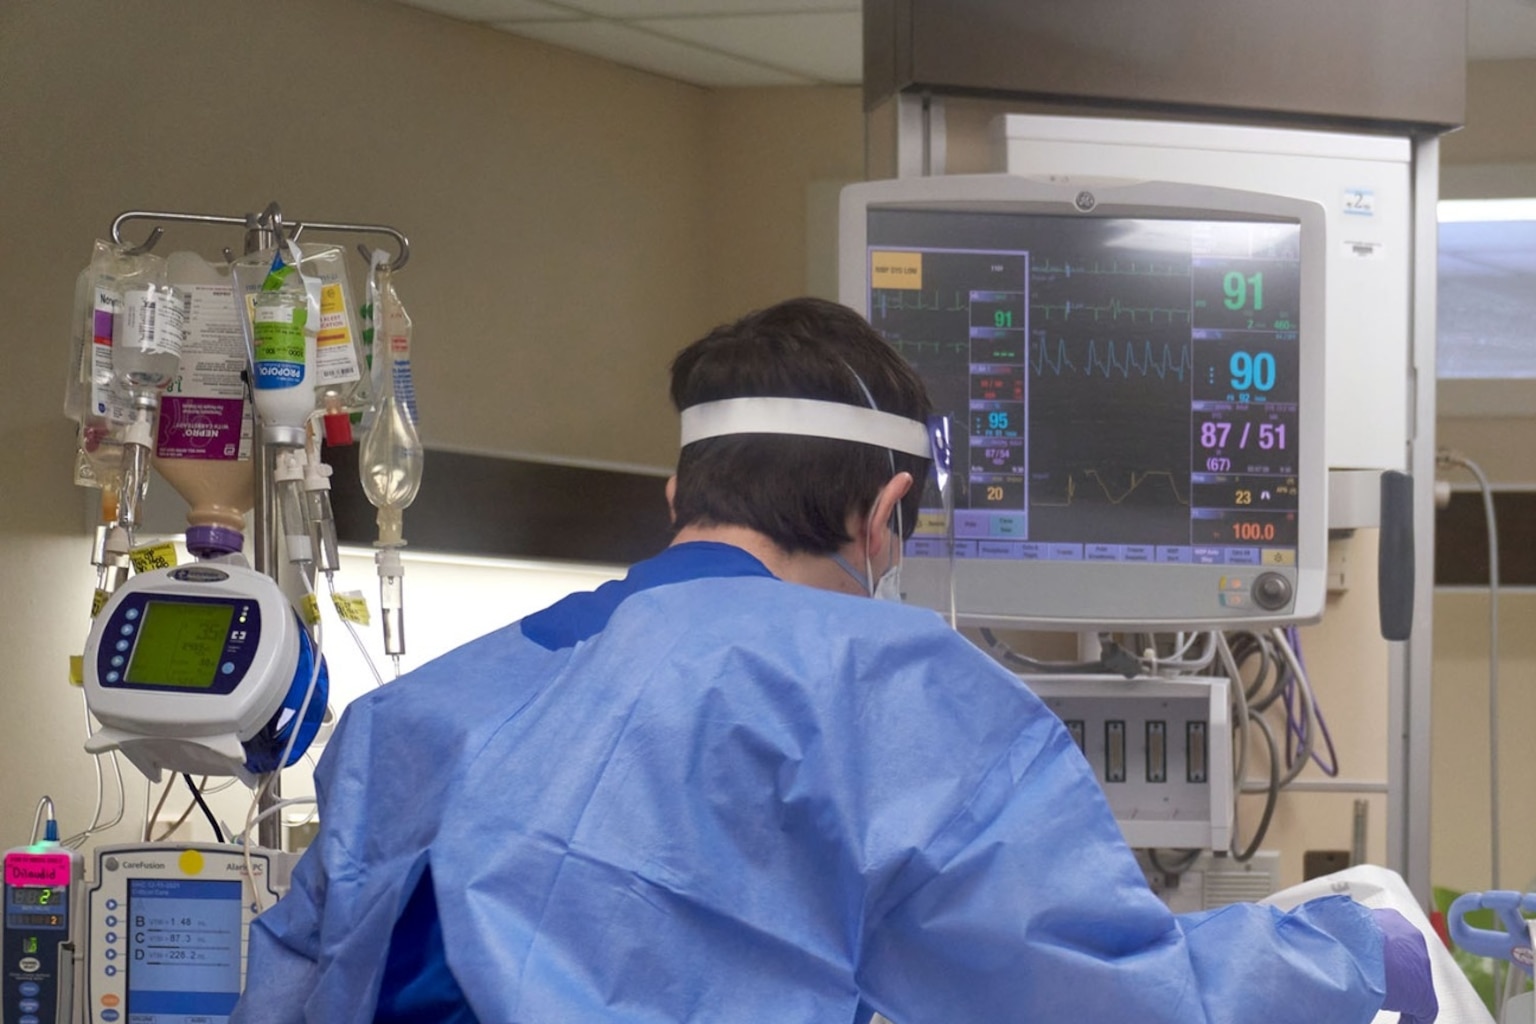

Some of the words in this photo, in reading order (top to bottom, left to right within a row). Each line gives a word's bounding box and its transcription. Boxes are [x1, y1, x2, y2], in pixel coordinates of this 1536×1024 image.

[1223, 271, 1263, 310] 91
[994, 311, 1012, 328] 91
[259, 367, 301, 378] PROPOFOL
[1229, 351, 1276, 391] 90
[988, 413, 1009, 429] 95
[185, 429, 220, 437] NEPRO
[1201, 423, 1232, 448] 87
[1240, 423, 1250, 449] /
[1259, 424, 1286, 450] 51
[1206, 457, 1231, 472] (67)
[986, 486, 1004, 501] 20
[1235, 491, 1252, 505] 23
[1233, 523, 1275, 541] 100.0
[122, 861, 165, 870] CareFusion
[39, 890, 51, 905] 2
[135, 916, 146, 927] B
[135, 934, 145, 944] C
[135, 949, 145, 960] D
